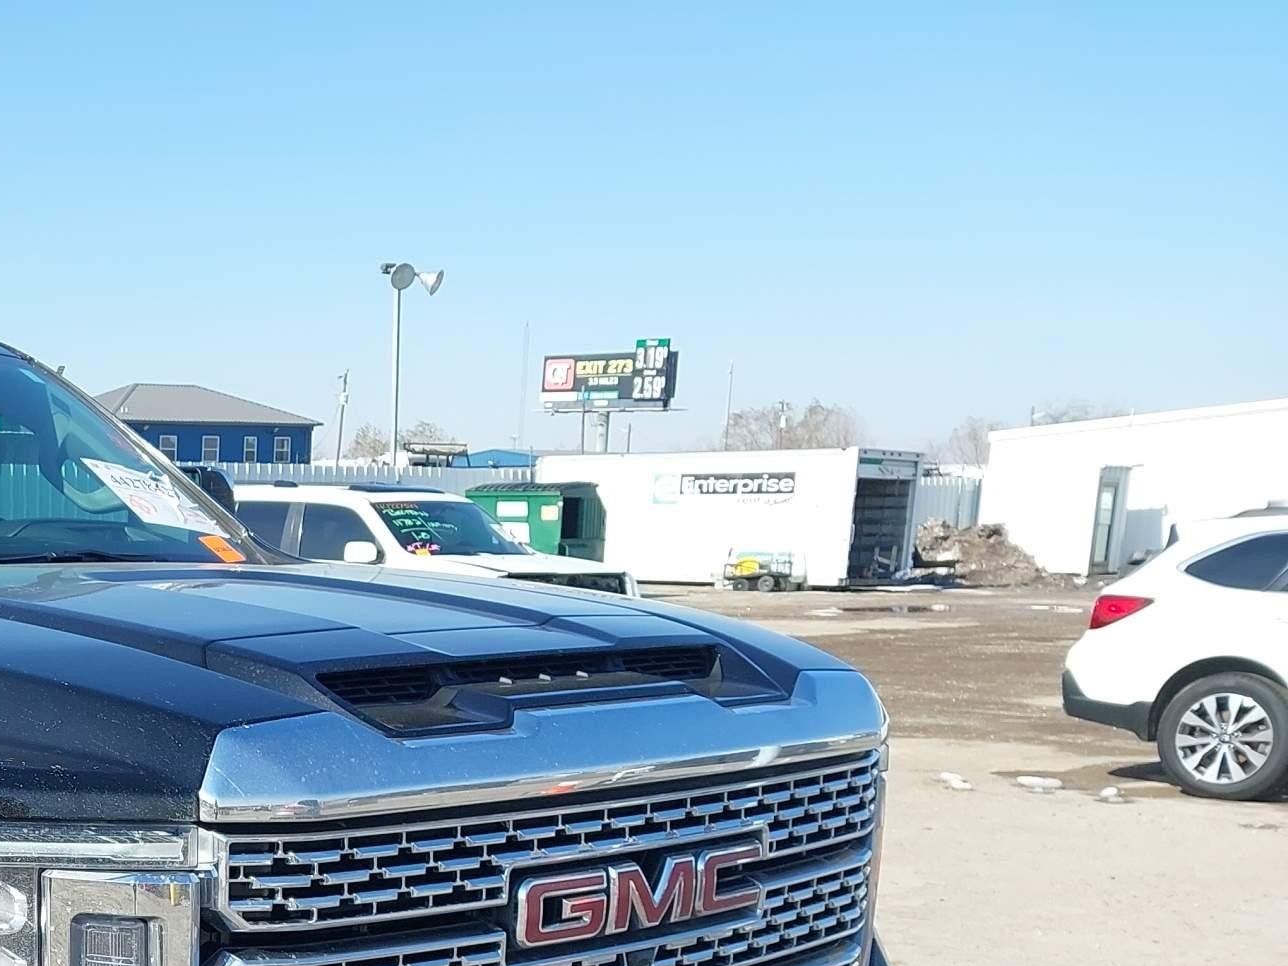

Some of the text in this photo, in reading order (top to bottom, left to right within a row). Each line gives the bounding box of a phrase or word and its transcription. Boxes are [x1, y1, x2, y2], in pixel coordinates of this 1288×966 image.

[576, 359, 633, 375] EXIT 273
[681, 474, 795, 494] Enterprise
[516, 840, 762, 948] GMC
